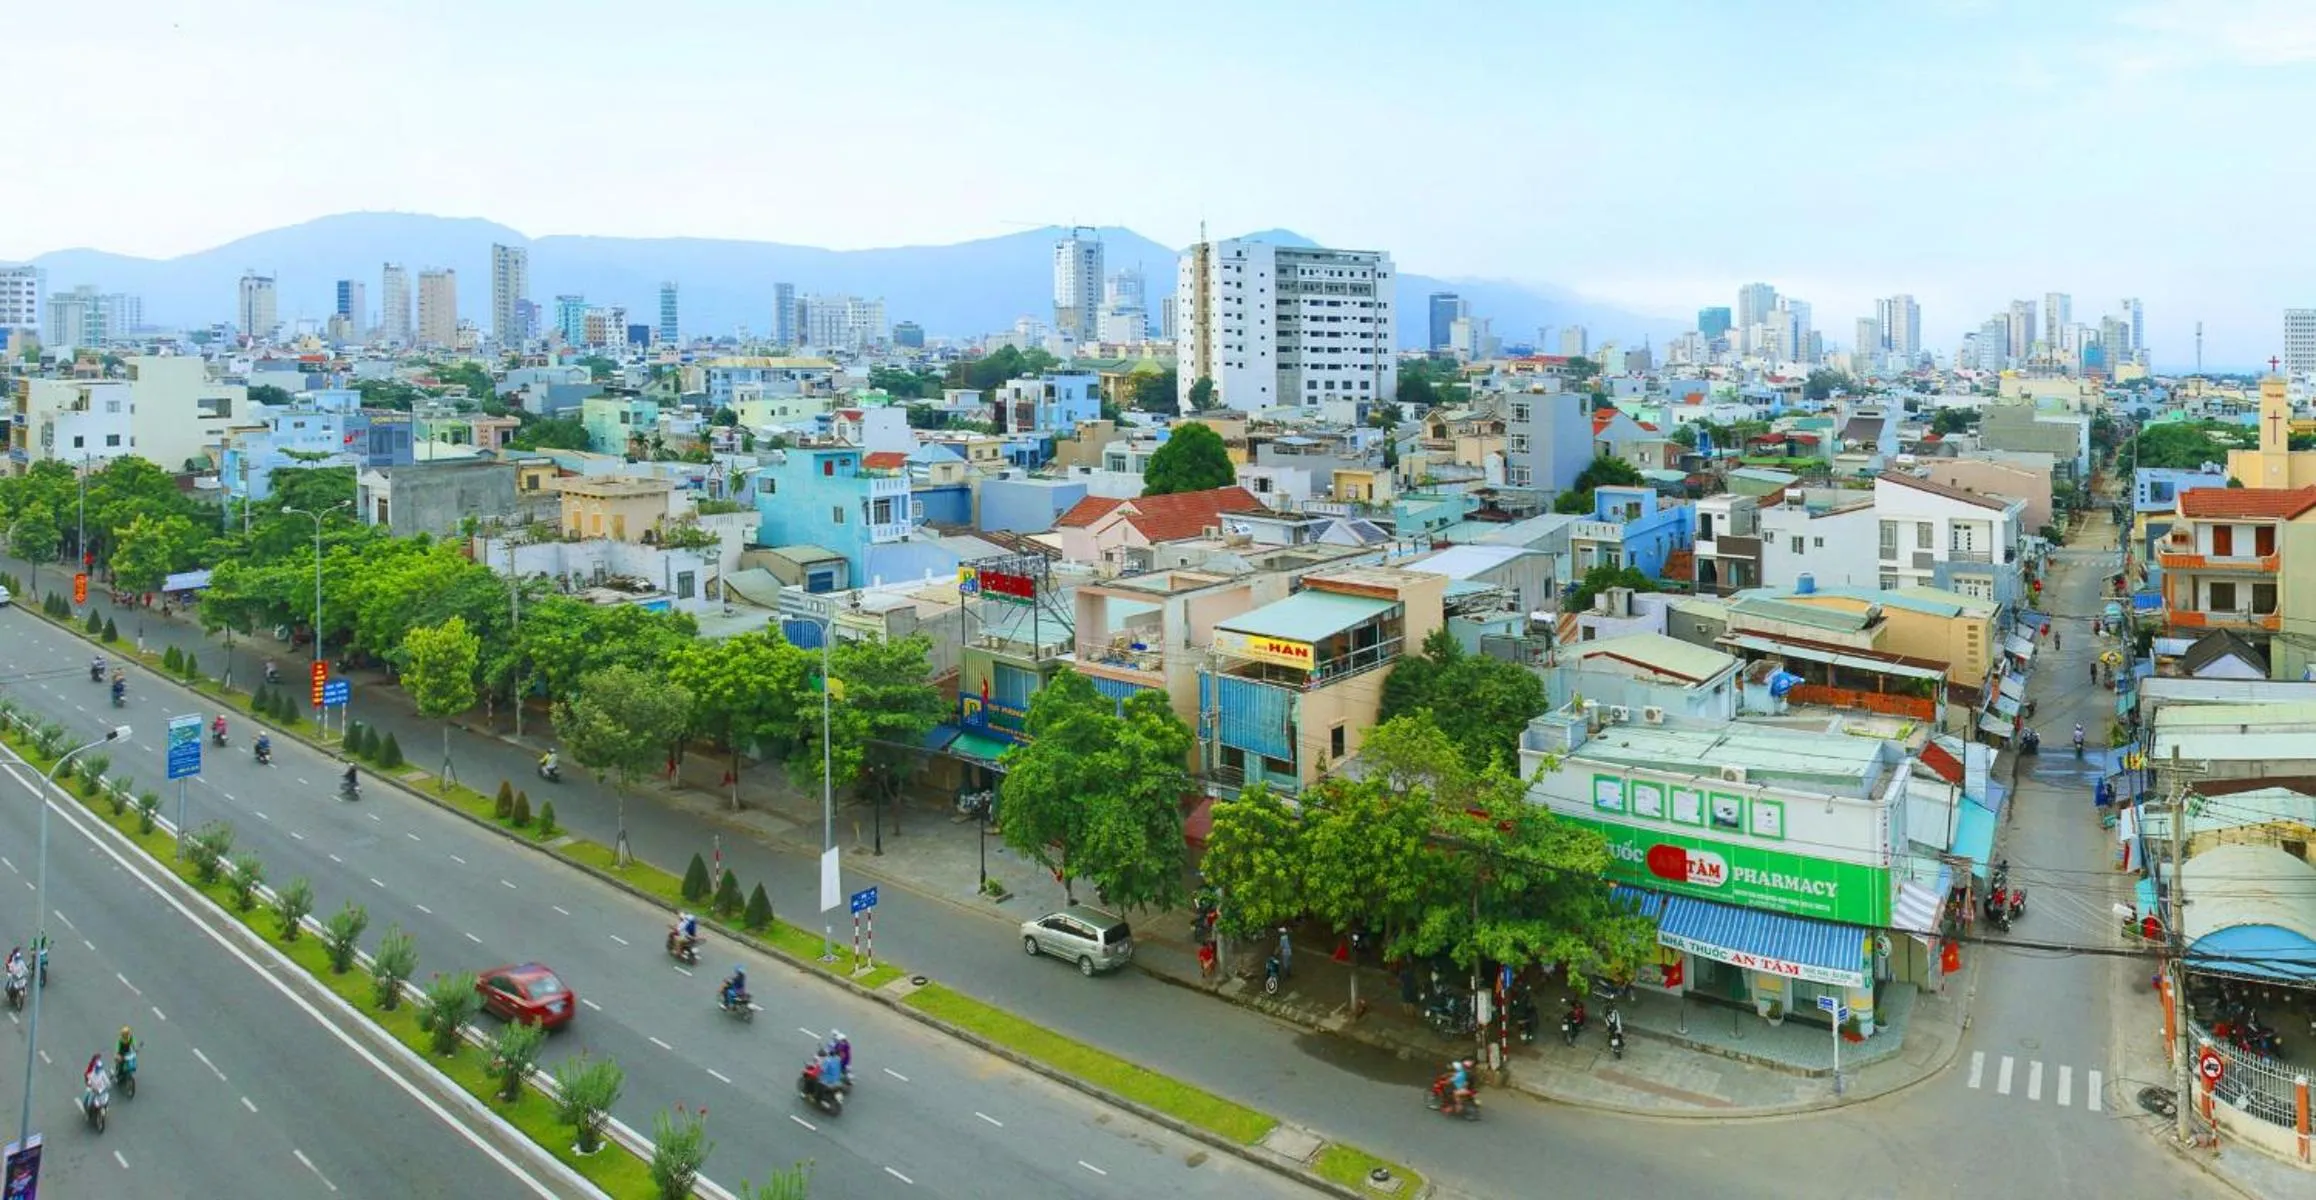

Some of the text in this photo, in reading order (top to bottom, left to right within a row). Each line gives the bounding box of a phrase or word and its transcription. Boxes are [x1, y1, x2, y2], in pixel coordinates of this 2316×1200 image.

[1687, 858, 1721, 878] TÂM
[1733, 866, 1837, 898] PHARMACY
[1731, 953, 1756, 966] AN
[1760, 957, 1800, 975] TÂM
